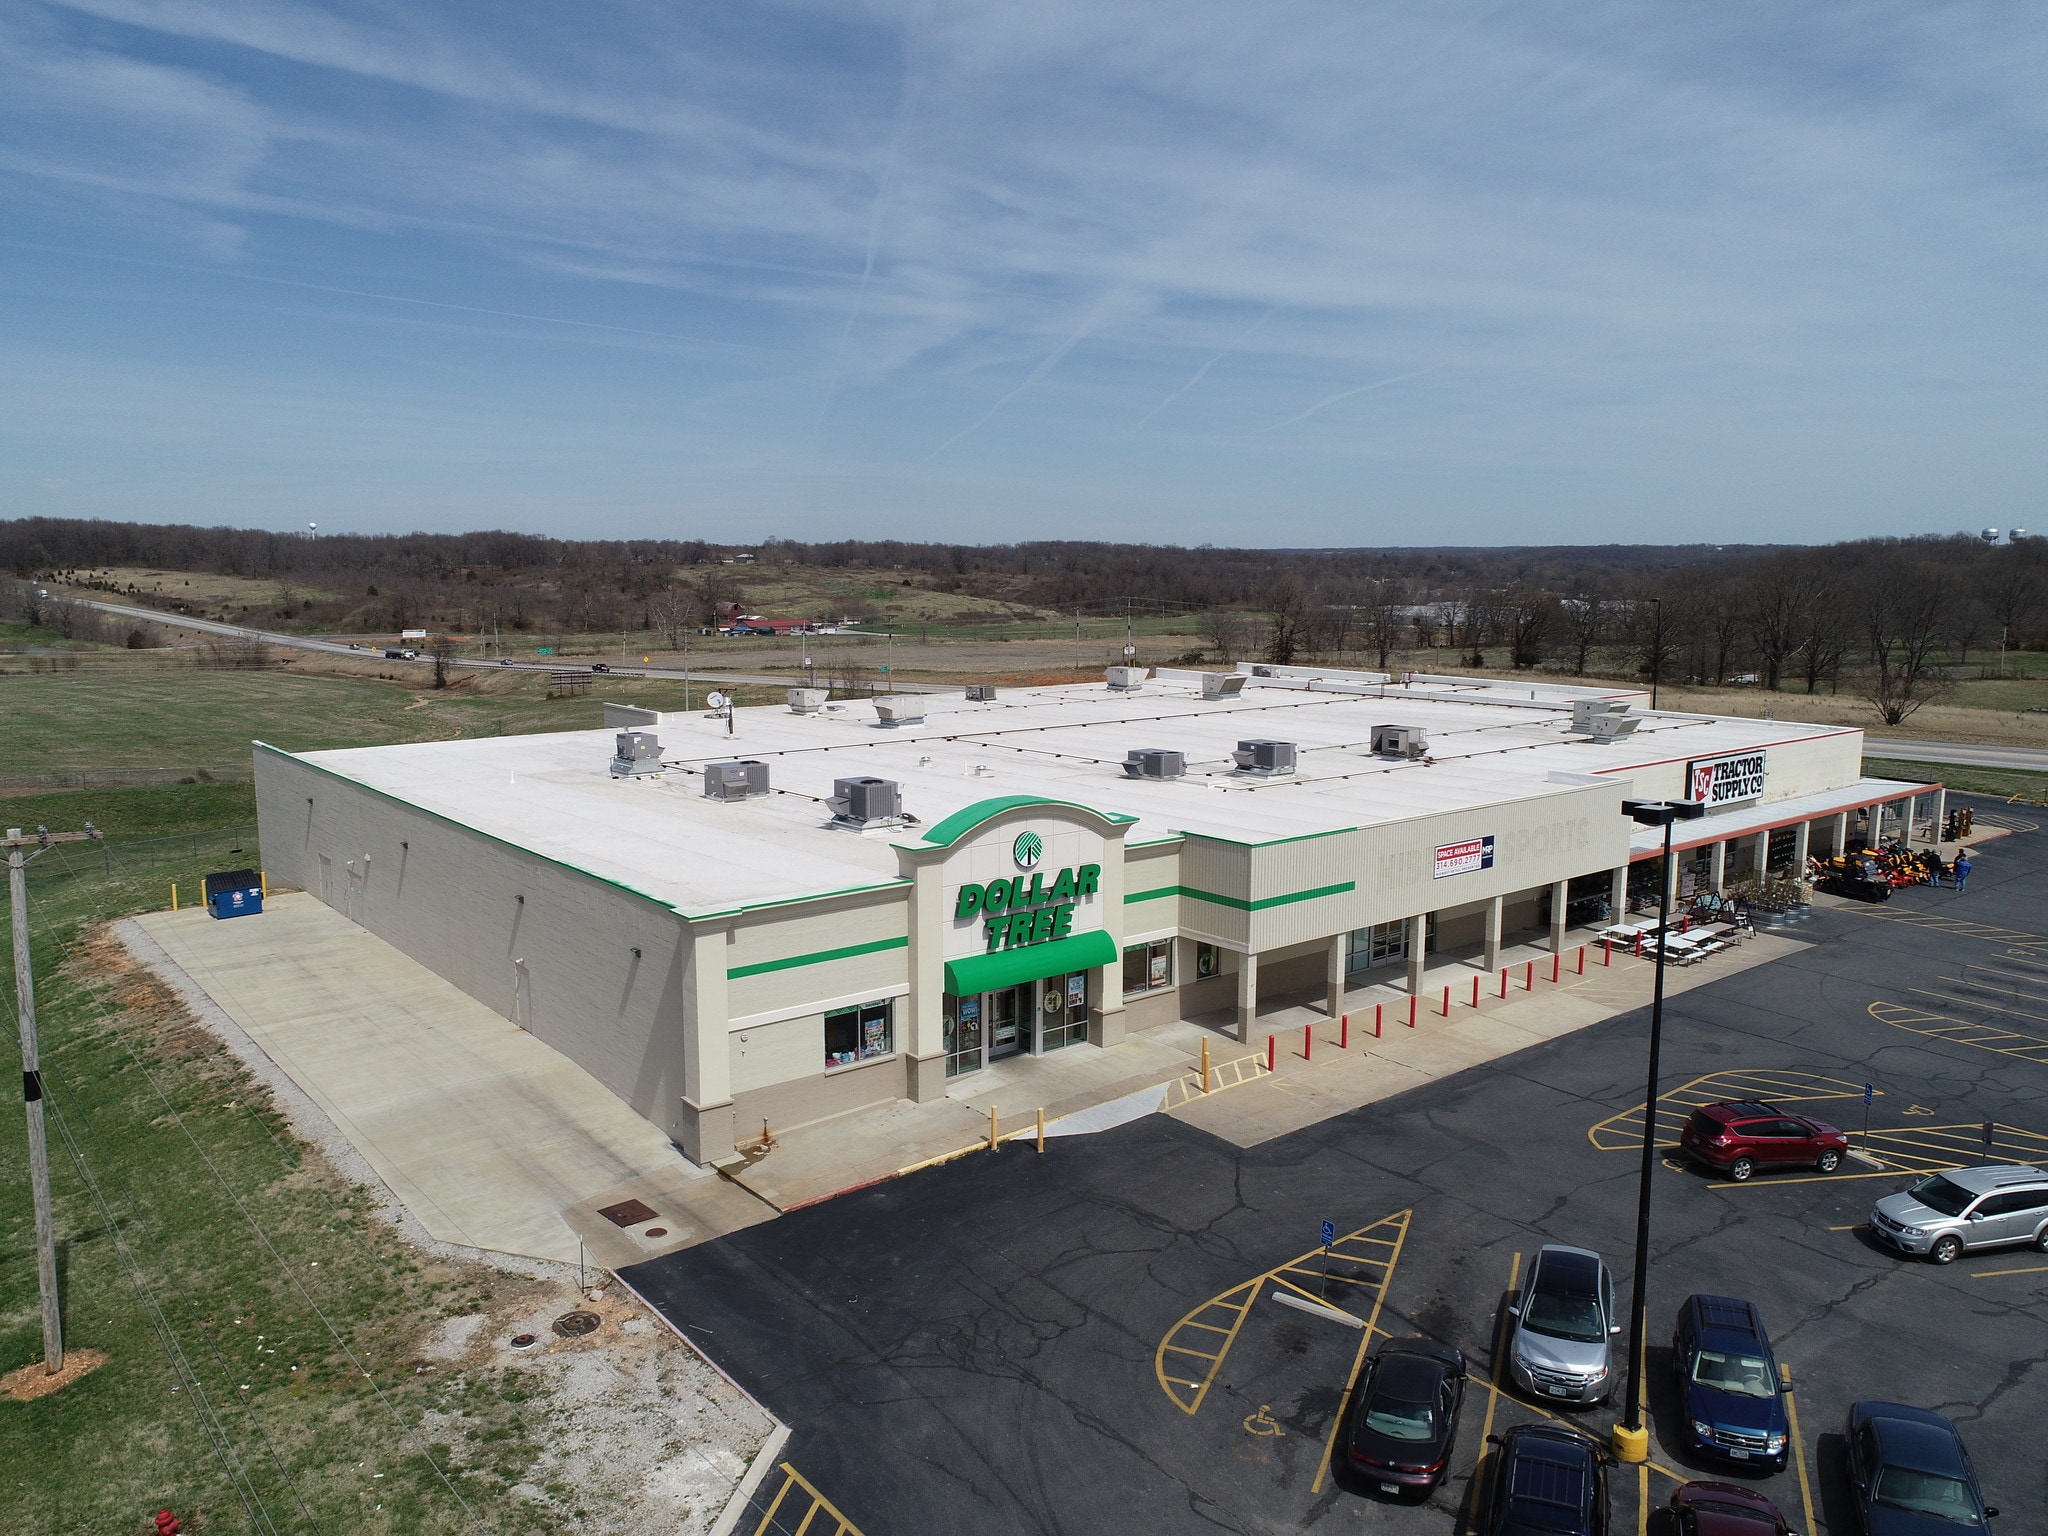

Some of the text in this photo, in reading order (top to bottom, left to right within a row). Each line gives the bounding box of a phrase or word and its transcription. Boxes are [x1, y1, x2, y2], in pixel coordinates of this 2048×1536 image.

[1714, 757, 1763, 781] TRACTOR
[1694, 769, 1709, 795] TSC
[1712, 777, 1751, 802] SUPPLY
[1436, 855, 1480, 869] 314.690.2777
[1437, 844, 1480, 858] SPACE AVAILABLE
[957, 864, 1101, 918] DOLLAR
[984, 903, 1076, 952] TREE
